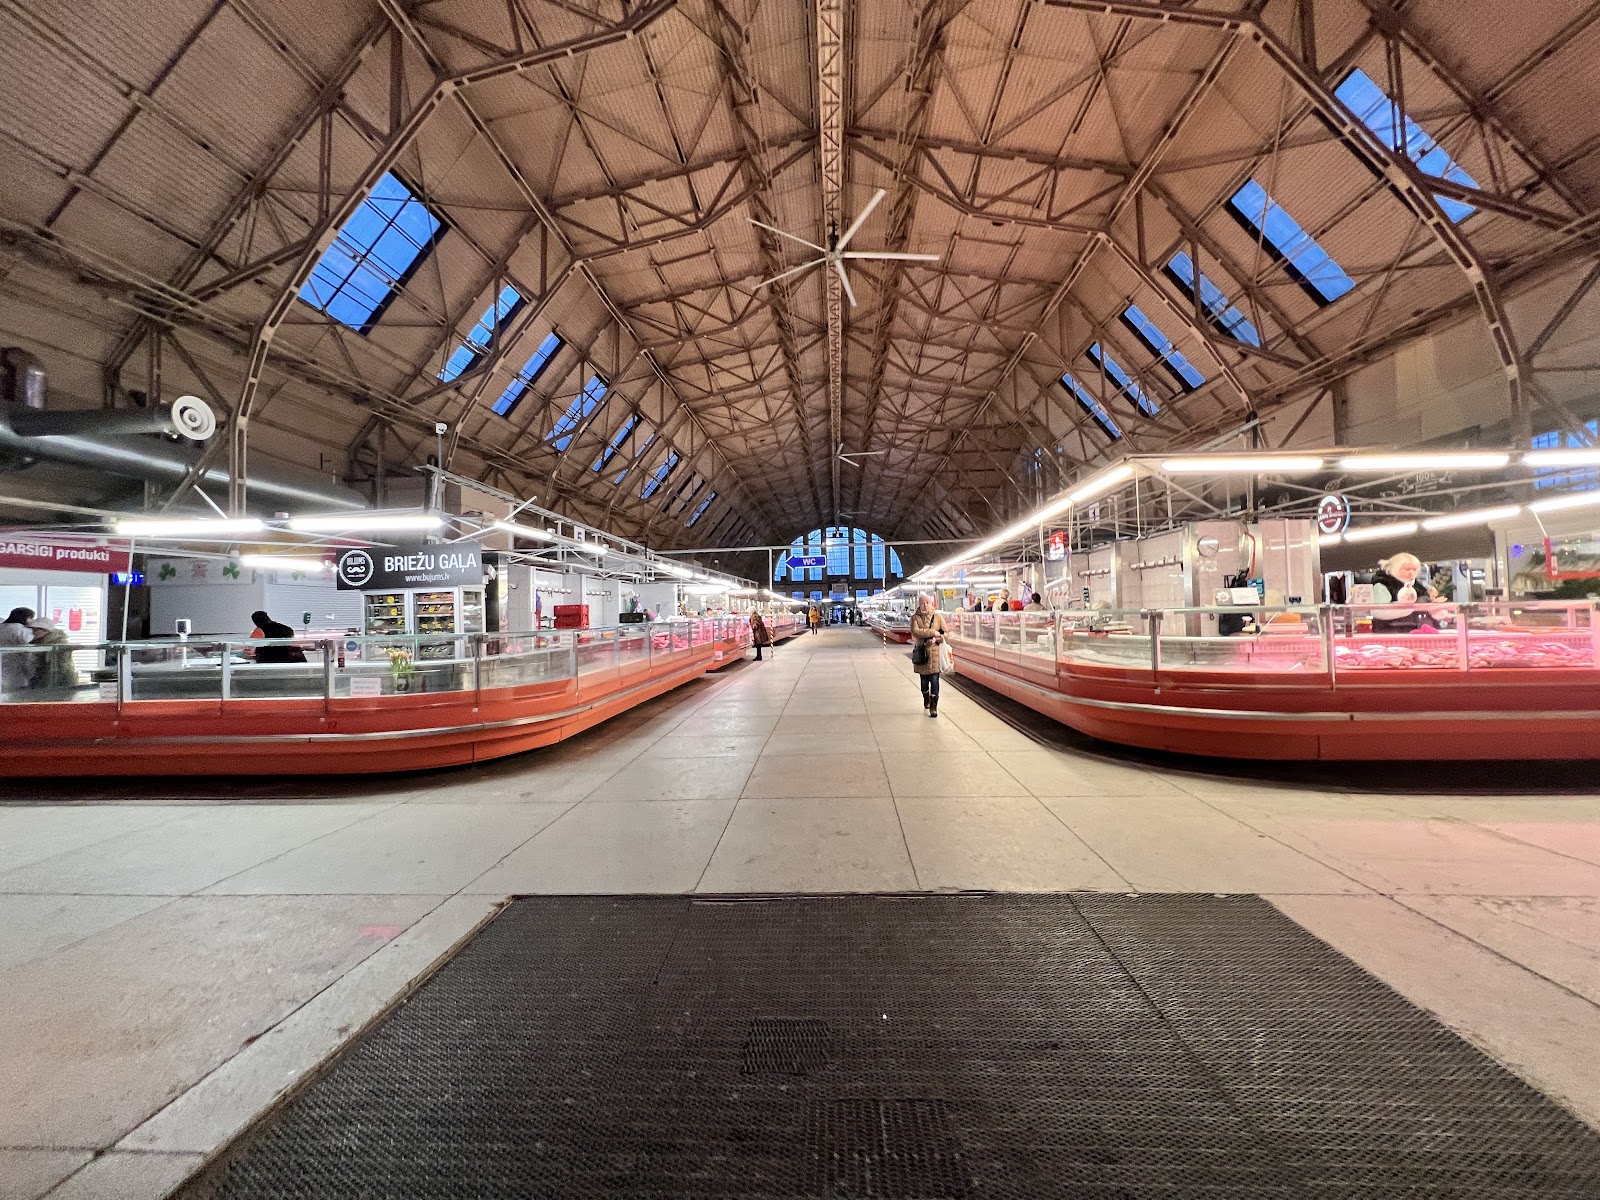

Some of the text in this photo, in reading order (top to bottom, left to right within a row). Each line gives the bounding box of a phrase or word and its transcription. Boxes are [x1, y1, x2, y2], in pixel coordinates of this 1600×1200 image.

[56, 549, 110, 560] produkti
[384, 552, 477, 573] BRIEŽU GAĻA
[802, 558, 816, 566] WC
[404, 573, 450, 583] www.bujums.lv
